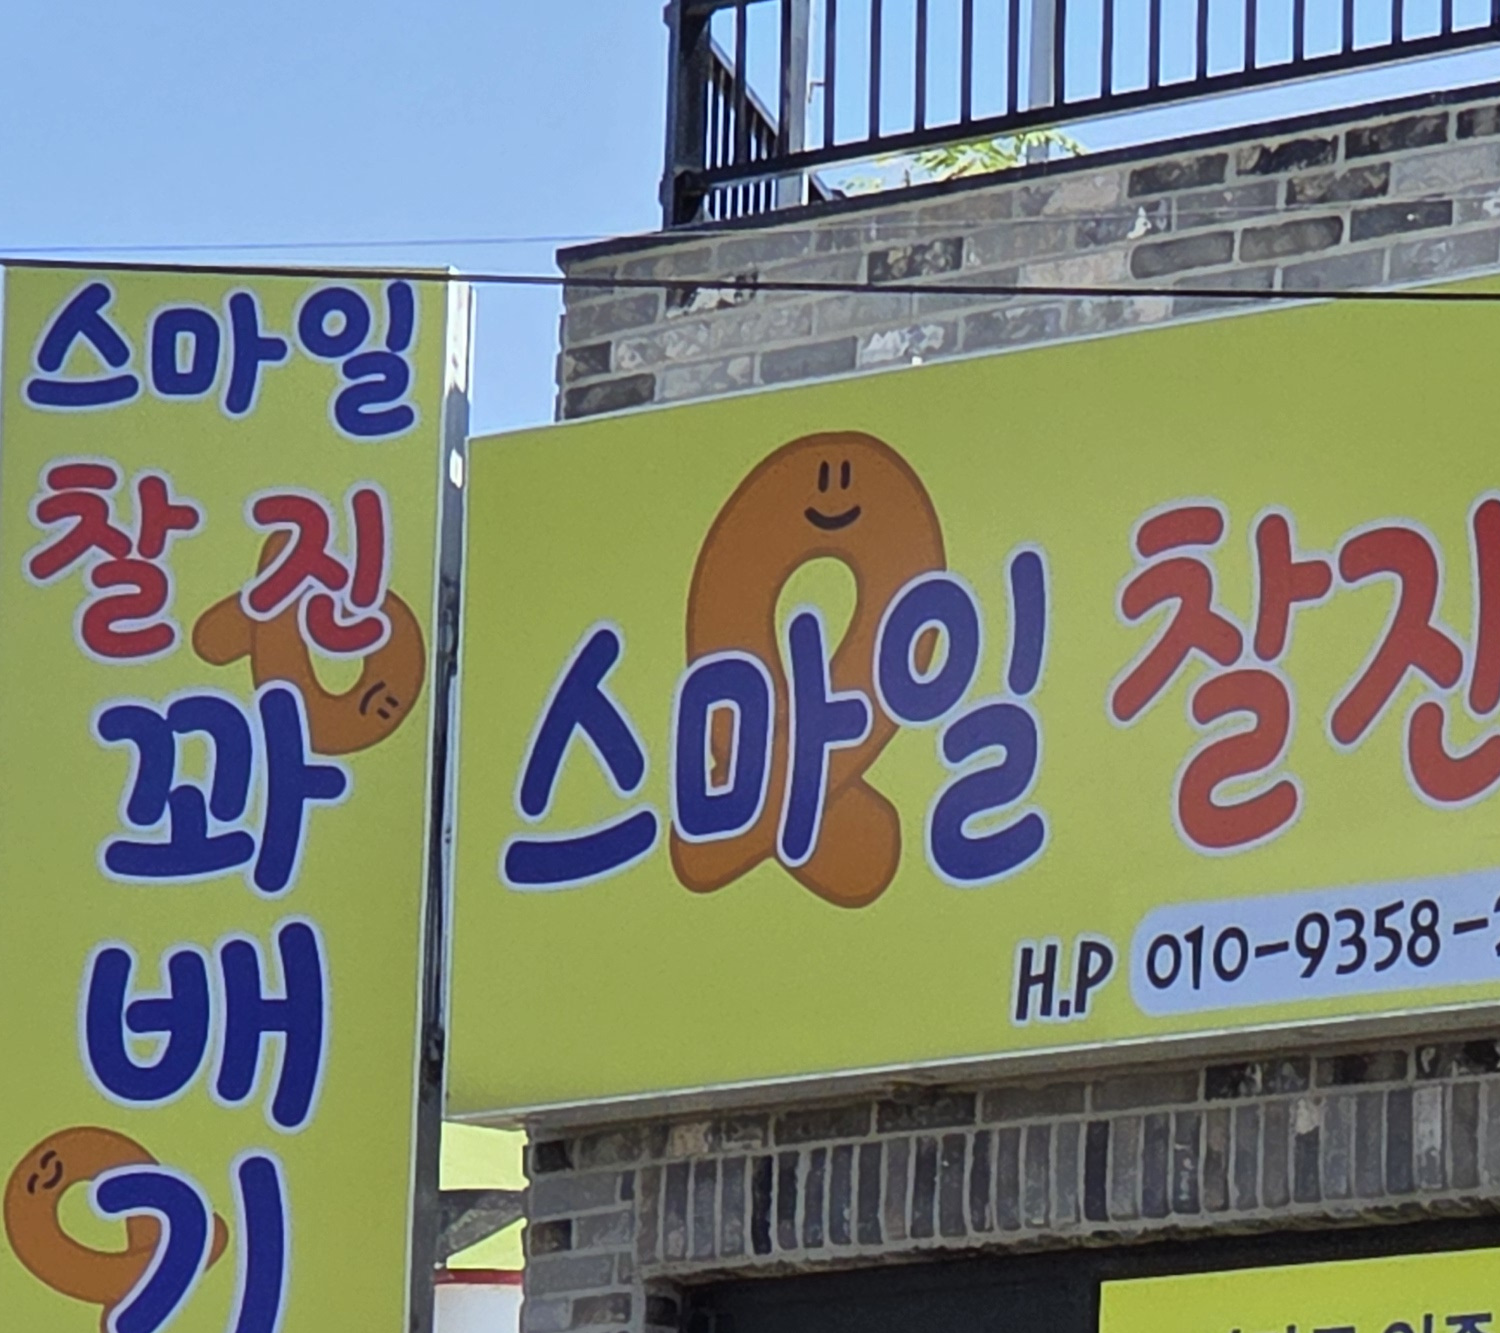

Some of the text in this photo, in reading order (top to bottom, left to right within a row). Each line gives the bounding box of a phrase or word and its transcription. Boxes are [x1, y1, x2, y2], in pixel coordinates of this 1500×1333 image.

[28, 280, 415, 438] 스마일
[30, 462, 393, 657] 찰진
[504, 550, 1047, 884] 스마일
[1015, 942, 1113, 1022] H.P
